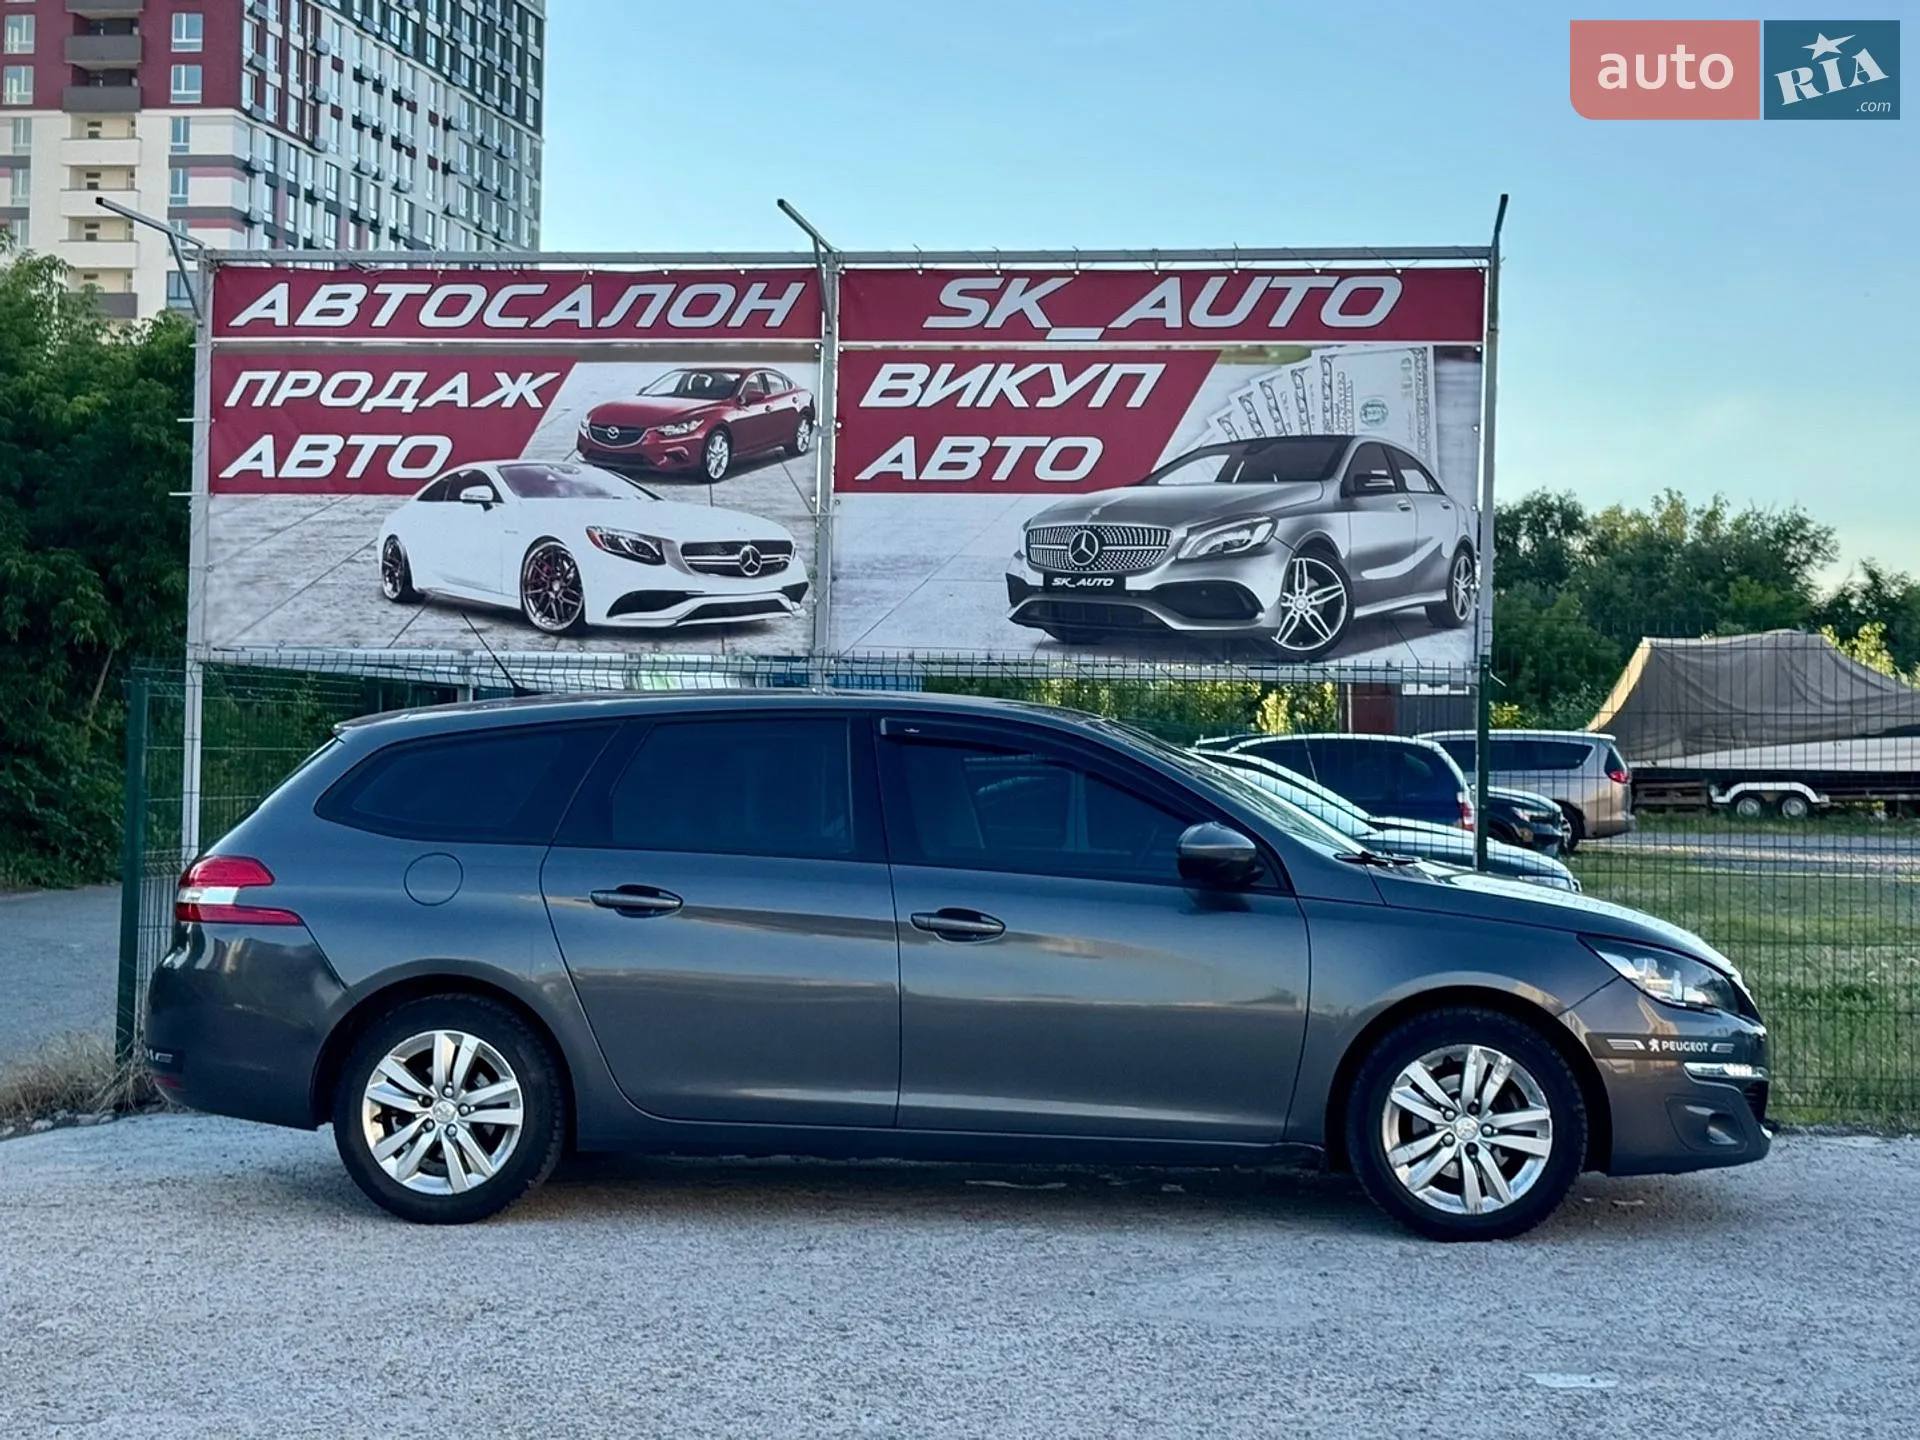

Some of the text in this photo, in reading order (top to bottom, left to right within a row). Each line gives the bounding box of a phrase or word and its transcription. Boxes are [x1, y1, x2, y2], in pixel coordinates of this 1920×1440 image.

[228, 282, 806, 329] АВТОСАЛОН
[922, 276, 1404, 340] SK_AUTO
[223, 370, 561, 413] ПРОДАЖ
[859, 362, 1167, 409] ВИКУП
[218, 434, 453, 479] АВТО
[855, 435, 1104, 482] АВТО
[1051, 577, 1115, 588] SK_AUTO
[1660, 1040, 1709, 1053] PEUGEOT
